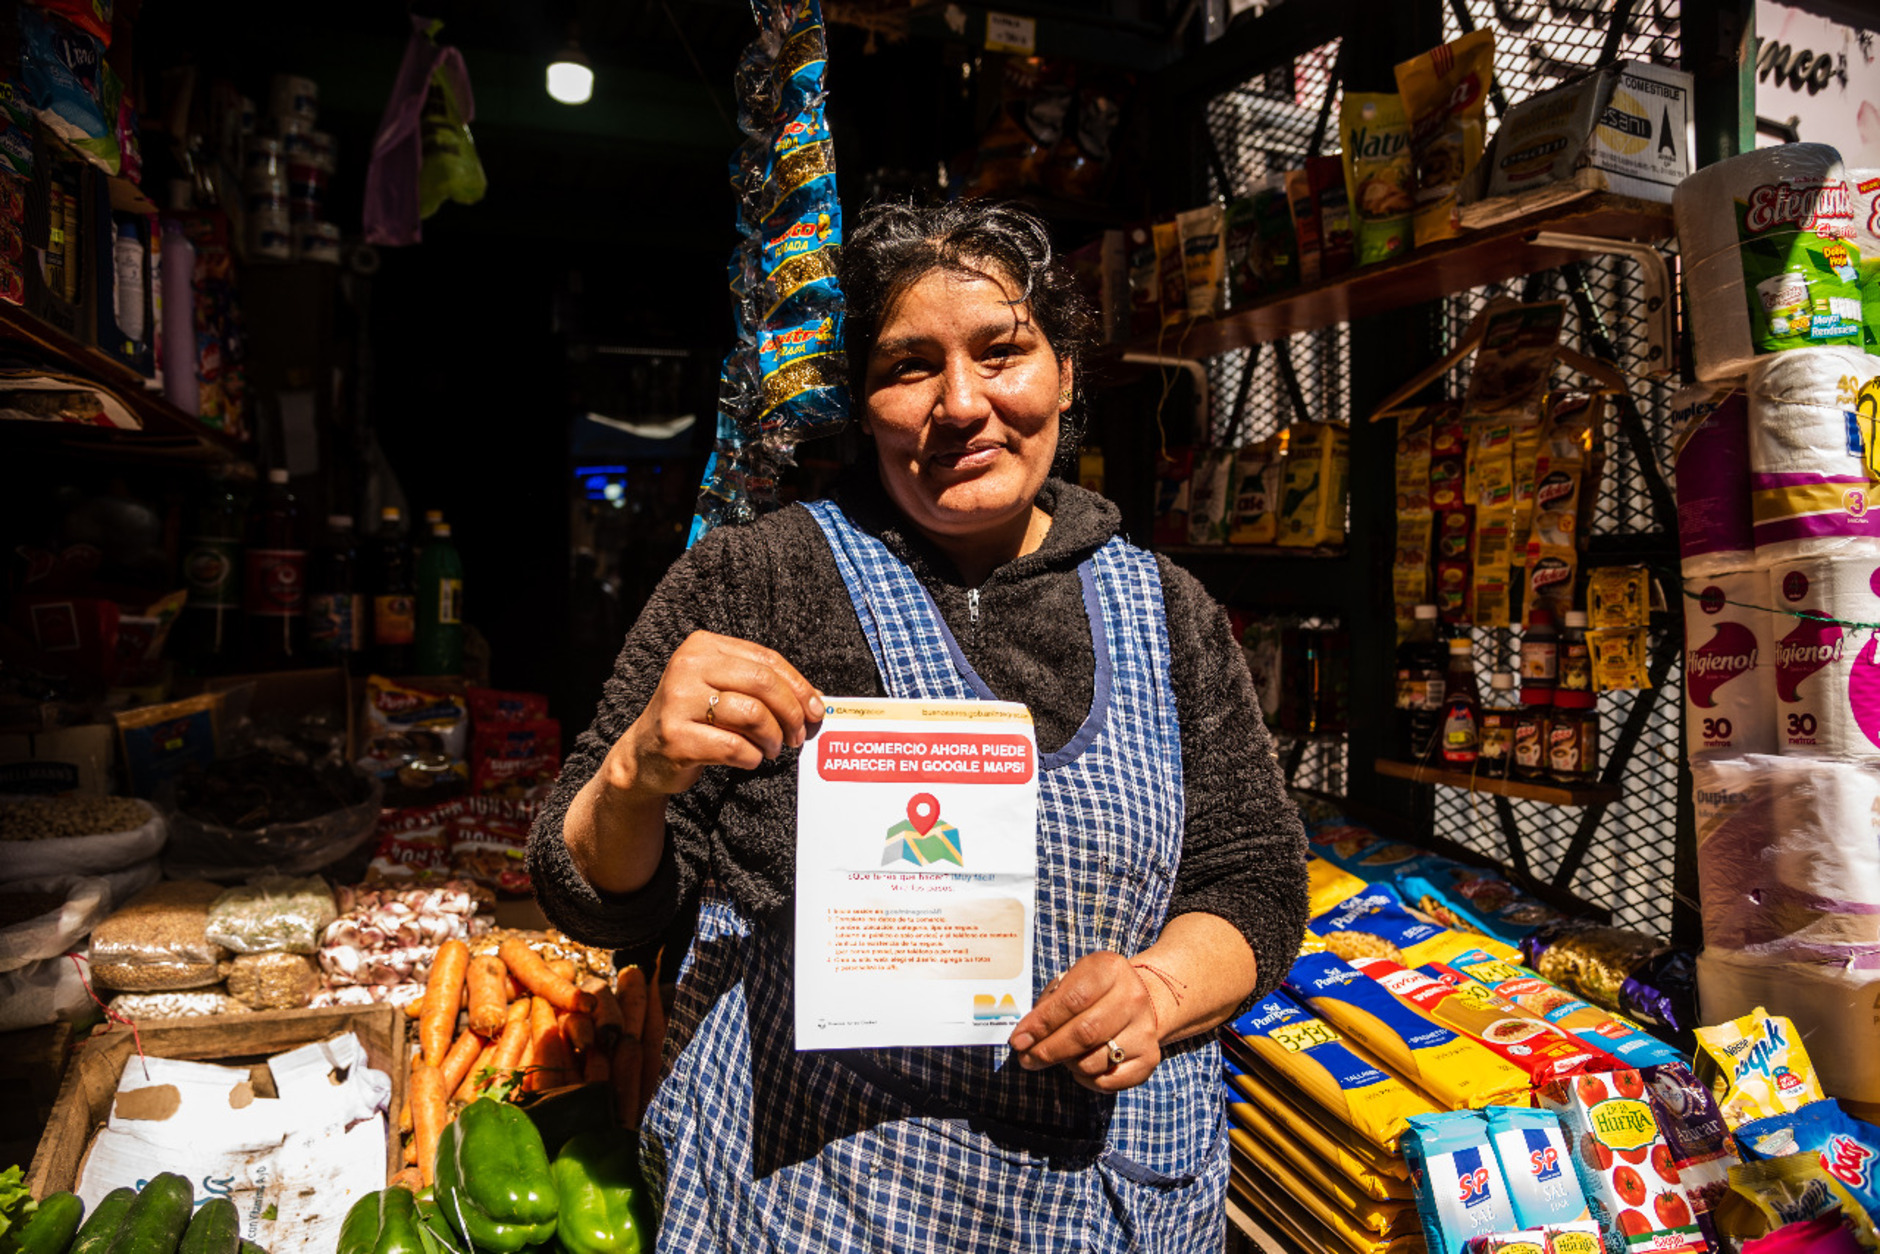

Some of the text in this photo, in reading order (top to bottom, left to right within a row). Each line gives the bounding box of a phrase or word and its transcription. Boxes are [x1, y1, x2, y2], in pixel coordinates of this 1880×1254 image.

[1626, 77, 1680, 101] COMESTIBLE
[1671, 401, 1719, 424] Duplex
[1849, 491, 1863, 514] 3
[1687, 648, 1758, 678] Higienol
[1775, 637, 1844, 671] Higienol
[1702, 718, 1732, 739] 30
[1787, 713, 1818, 736] 30
[853, 742, 927, 755] COMERCIO
[930, 743, 978, 756] AHORA
[982, 744, 1026, 757] PUEDE
[1704, 739, 1732, 748] metros
[1788, 736, 1816, 745] metros
[824, 758, 1025, 773] APARECER EN GOOGLE MAPS!
[1324, 967, 1341, 978] Sol
[1263, 1002, 1281, 1016] Sol
[1596, 1109, 1654, 1134] HUERTA
[1544, 1182, 1568, 1202] SAL
[1470, 1204, 1496, 1228] SAL
